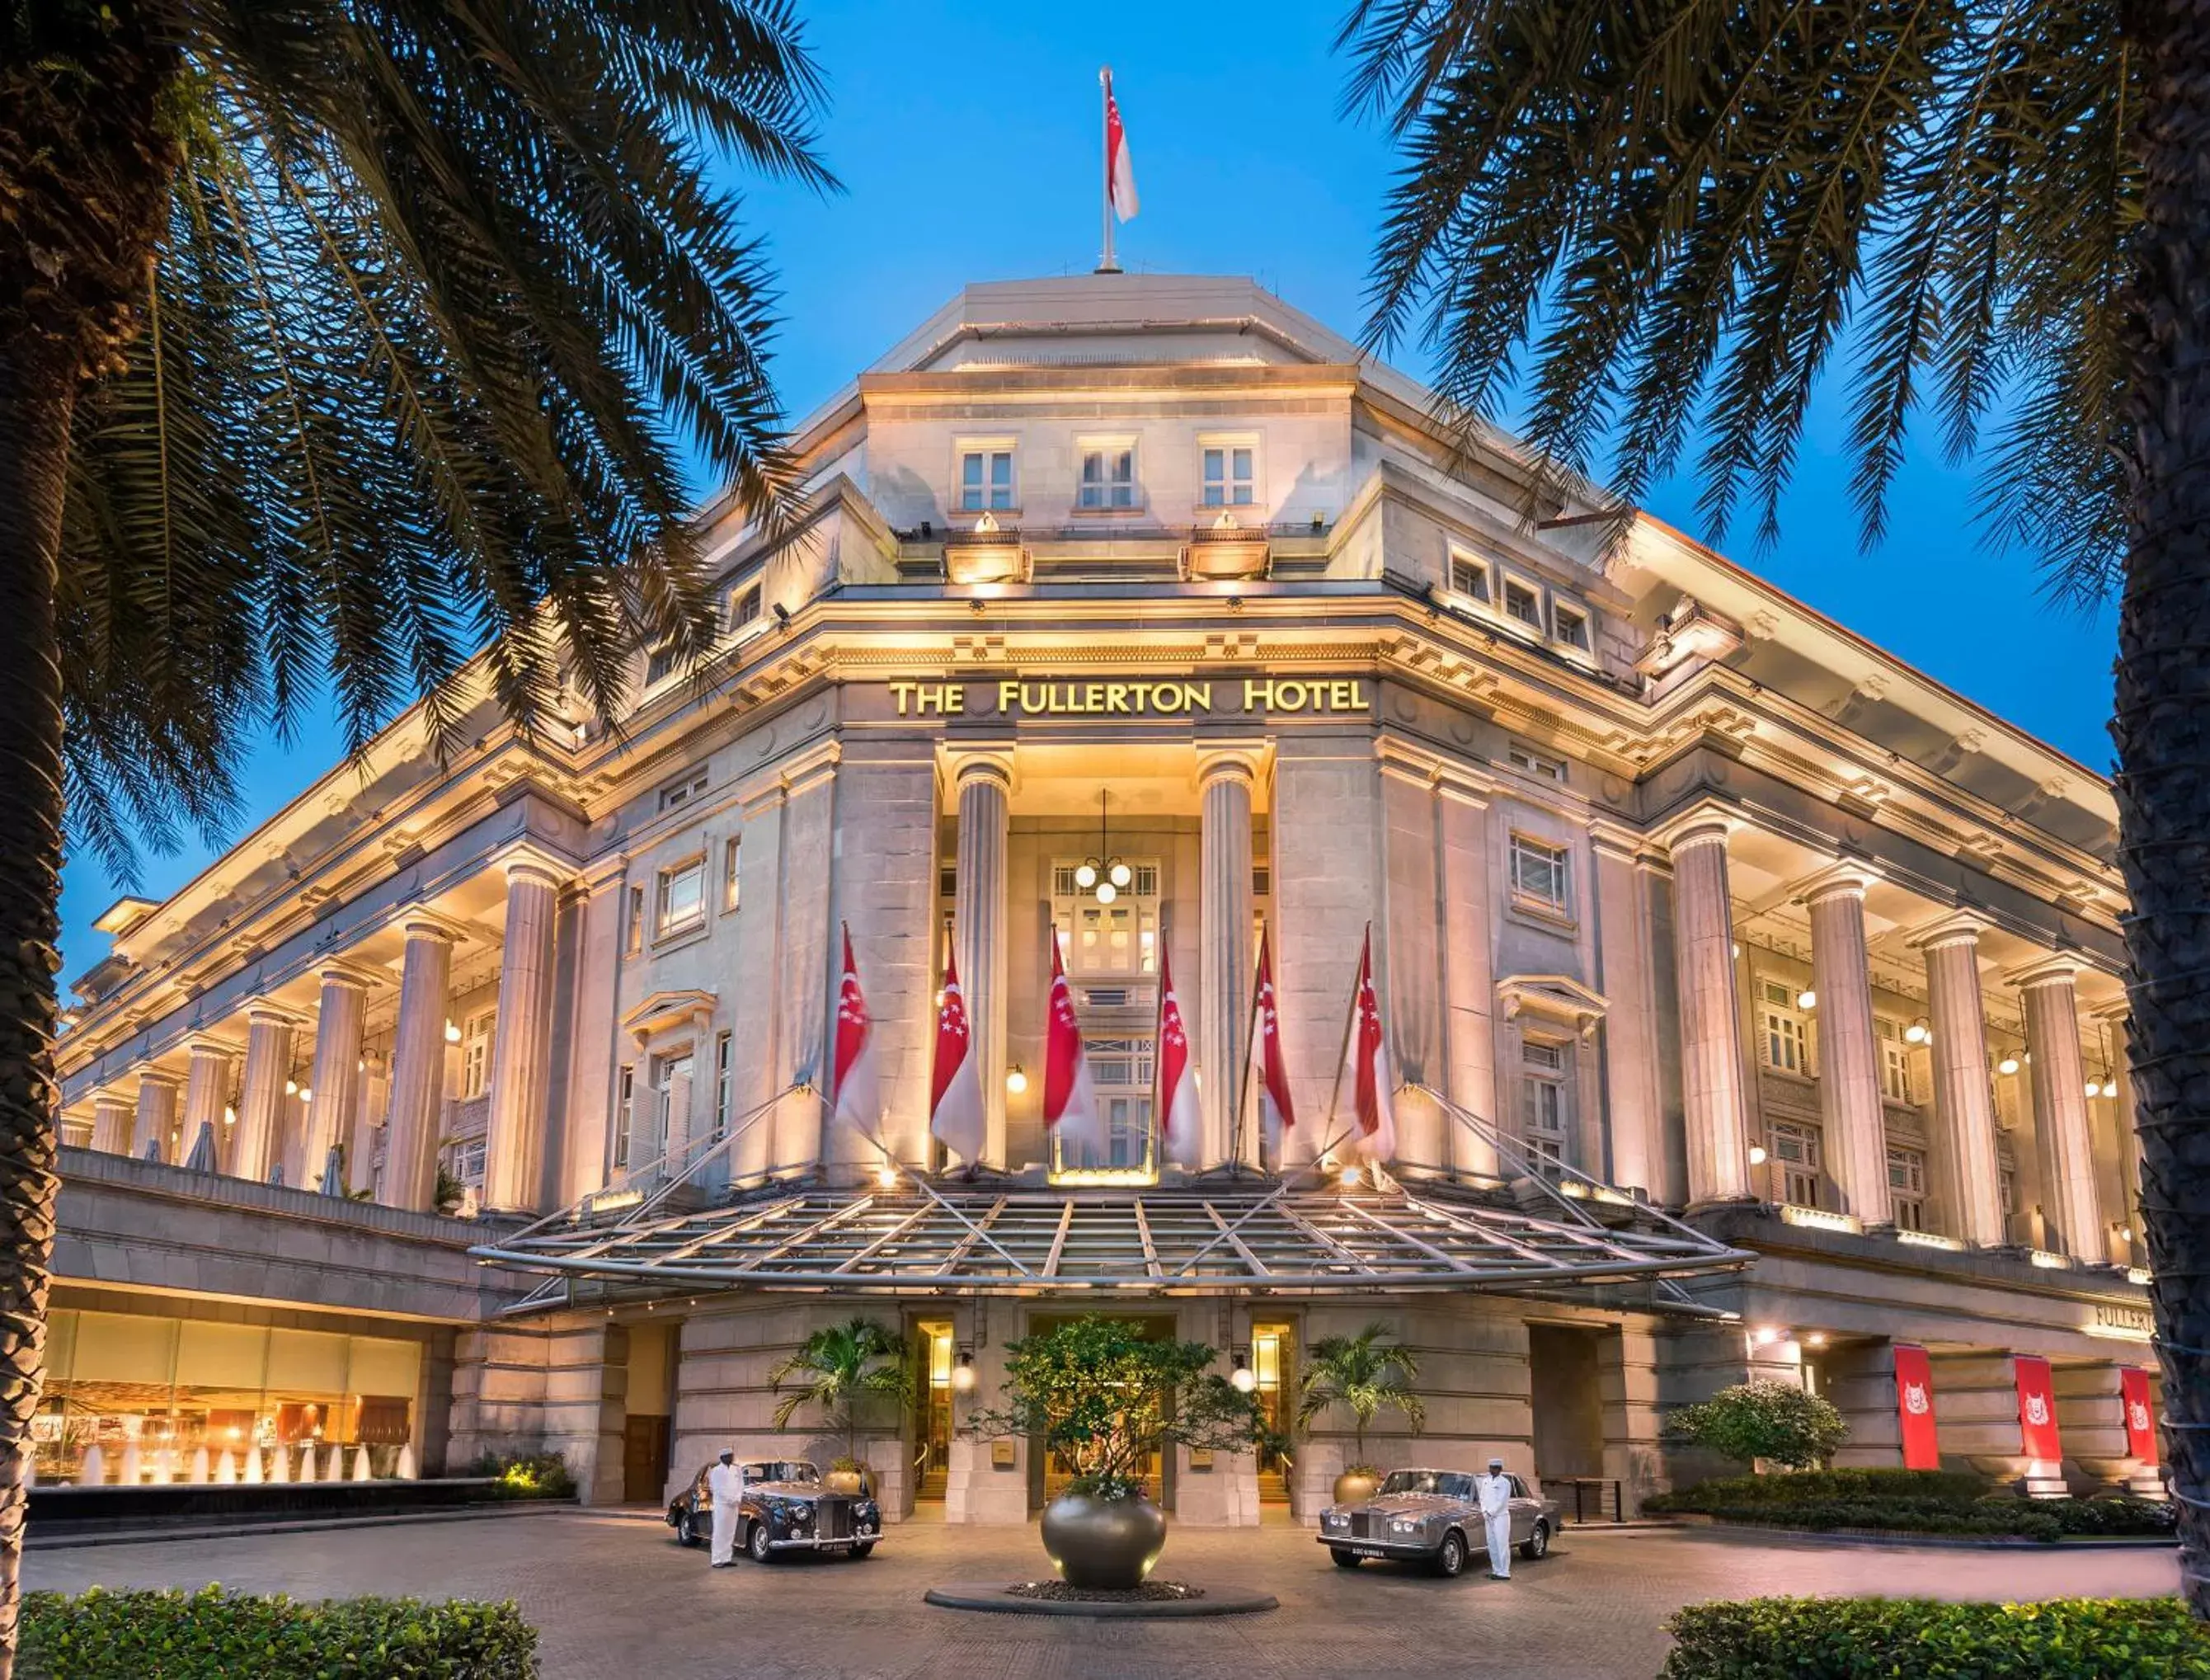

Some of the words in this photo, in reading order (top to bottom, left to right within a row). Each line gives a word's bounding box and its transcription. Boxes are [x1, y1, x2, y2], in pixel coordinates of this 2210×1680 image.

[889, 681, 964, 716] THE
[999, 680, 1211, 714] FULLERTON
[1244, 679, 1370, 713] HOTEL
